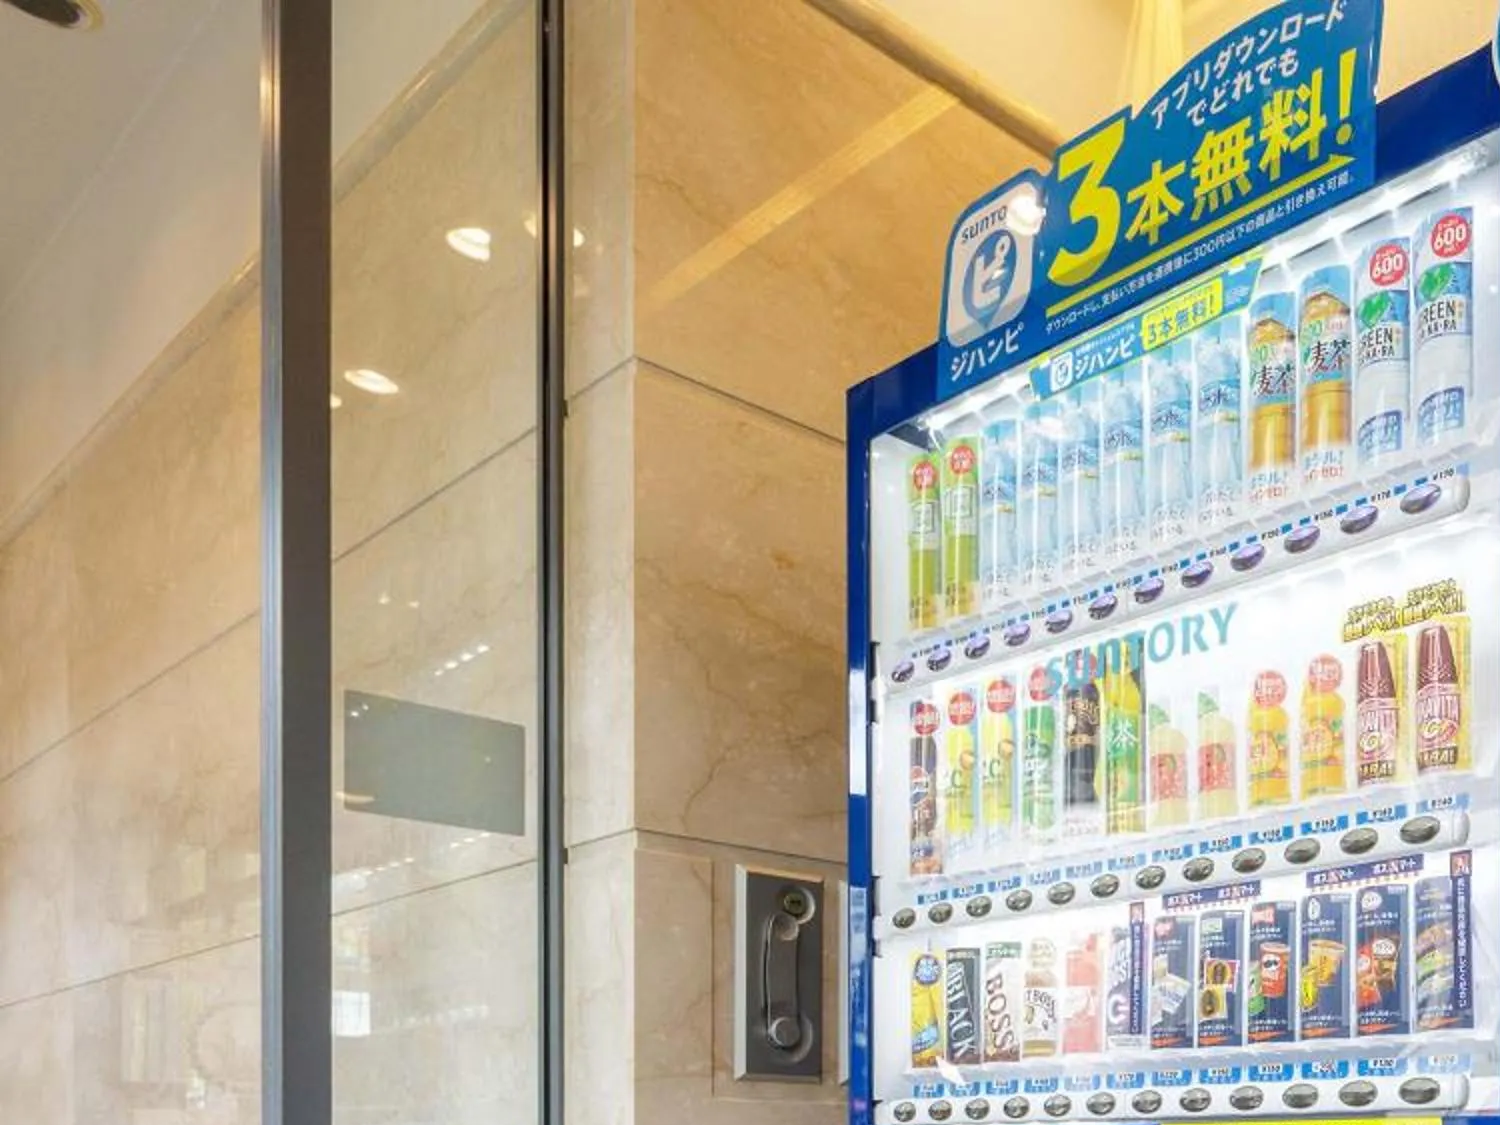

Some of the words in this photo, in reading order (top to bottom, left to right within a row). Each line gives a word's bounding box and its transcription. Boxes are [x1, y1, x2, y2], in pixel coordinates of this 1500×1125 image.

[1187, 48, 1299, 127] でどれでも
[1433, 225, 1467, 248] 600
[1372, 254, 1403, 279] 600
[1421, 299, 1456, 323] REEN
[951, 324, 1025, 382] ジハンピ
[1361, 327, 1393, 349] REEN
[1076, 333, 1136, 380] ジハンピ
[1045, 602, 1239, 698] SUNTORY
